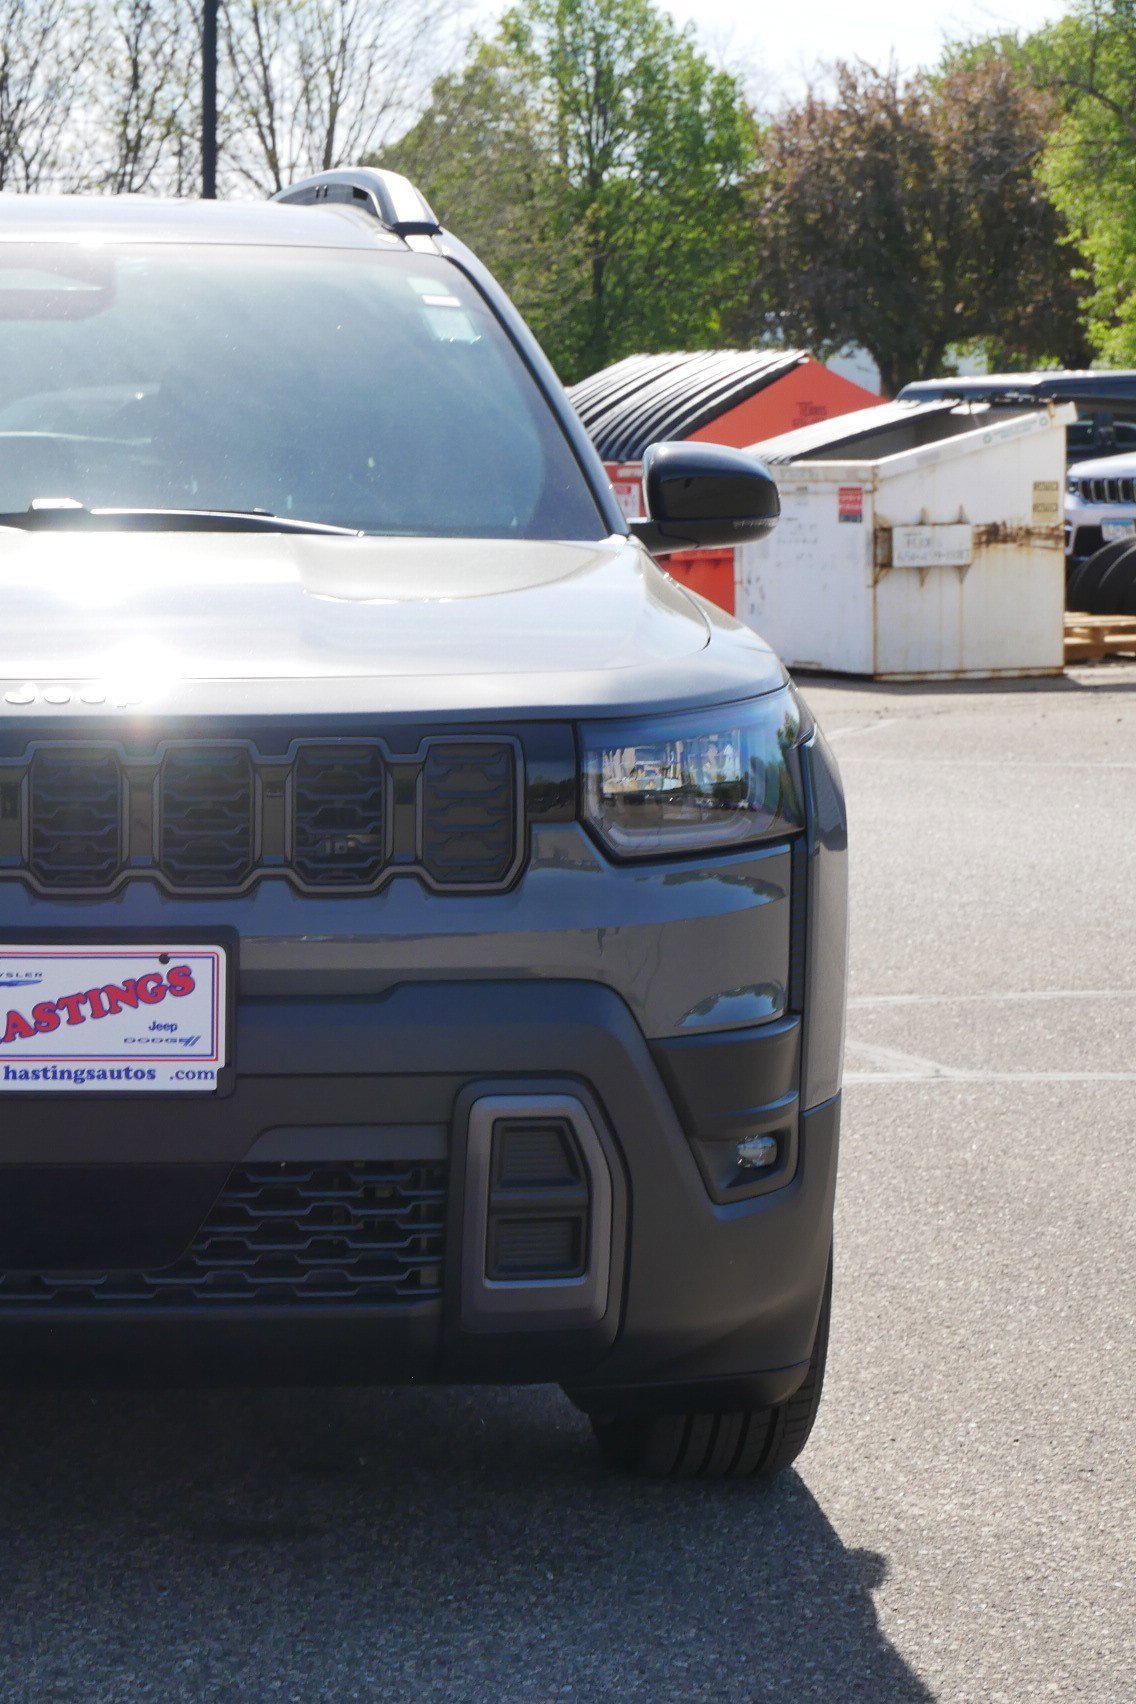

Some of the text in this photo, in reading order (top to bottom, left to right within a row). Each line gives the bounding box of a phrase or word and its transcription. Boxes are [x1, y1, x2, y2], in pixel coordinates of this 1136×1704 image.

[148, 1021, 178, 1033] Jeep
[3, 1065, 156, 1084] hastingsautos
[169, 1069, 215, 1080] .com
